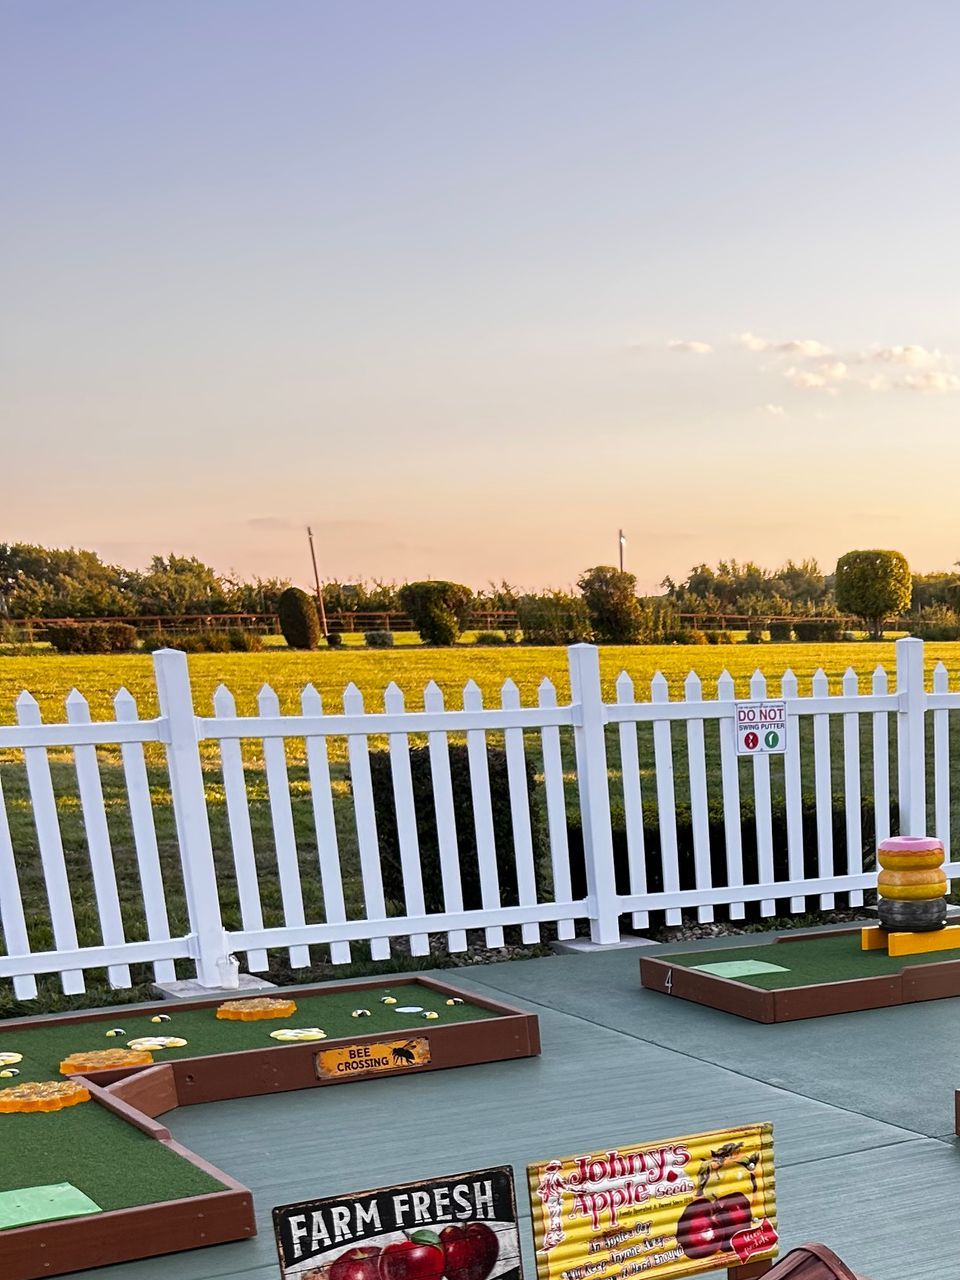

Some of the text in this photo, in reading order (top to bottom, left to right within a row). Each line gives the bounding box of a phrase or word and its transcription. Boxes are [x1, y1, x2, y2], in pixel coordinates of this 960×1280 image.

[738, 708, 784, 721] DO NOT
[664, 968, 673, 994] 4
[349, 1047, 371, 1059] BEE
[336, 1056, 389, 1072] CROSSING
[568, 1181, 650, 1230] Apple
[288, 1180, 497, 1258] FARM FRESH
